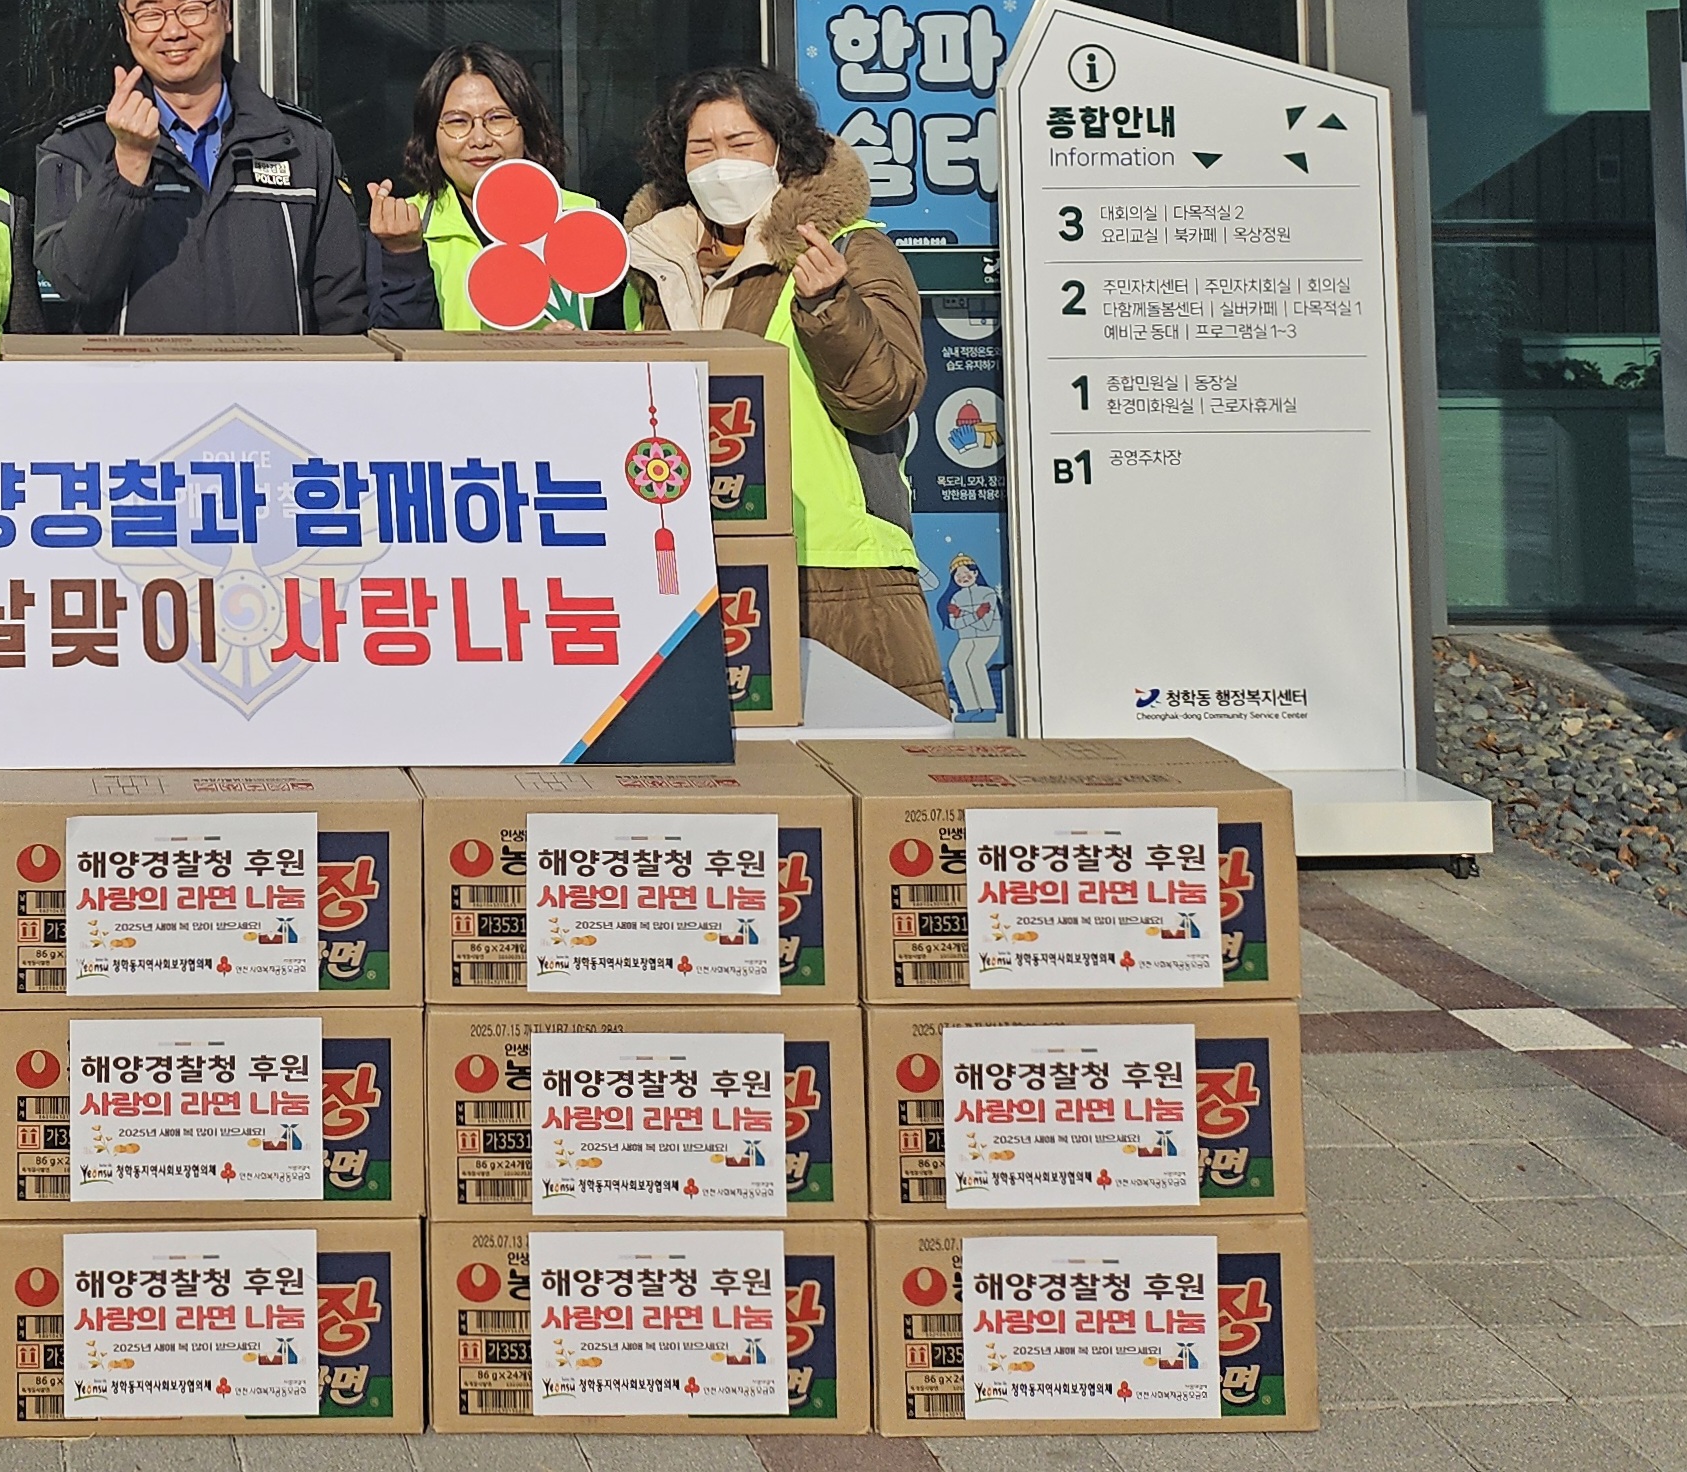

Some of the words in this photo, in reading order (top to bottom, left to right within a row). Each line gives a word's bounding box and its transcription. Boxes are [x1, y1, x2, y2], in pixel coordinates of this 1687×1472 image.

[827, 6, 1005, 98] 한파
[1047, 106, 1175, 138] 종합안내
[1050, 147, 1174, 166] Information
[255, 172, 290, 186] POLICE
[1100, 205, 1158, 221] 대회의실
[1173, 205, 1231, 221] 다목적실
[1235, 206, 1245, 220] 2
[1058, 206, 1084, 242] 3
[1101, 228, 1159, 244] 요리교실
[1174, 228, 1217, 244] 북카페
[1233, 227, 1291, 243] 옥상정원
[1102, 279, 1189, 295] 주민자치센터
[1204, 278, 1291, 295] 주민자치회실
[1307, 278, 1351, 294] 회의실
[1061, 279, 1087, 316] 2
[1103, 301, 1204, 318] 다함께돌봄센터
[1220, 301, 1278, 317] 실버카페
[1293, 301, 1352, 317] 다목적실
[1355, 301, 1362, 315] 1
[1104, 324, 1147, 340] 예비군
[1150, 324, 1179, 340] 동대
[1195, 324, 1267, 340] 프로그램실
[1270, 324, 1297, 339] 1~3
[942, 347, 959, 357] 실내
[946, 360, 964, 371] 습도
[965, 360, 999, 371] 유지하기
[1071, 375, 1089, 411] 1
[1106, 375, 1179, 392] 종합민원실
[1194, 375, 1238, 392] 동장실
[1107, 398, 1194, 415] 환경미화원실
[1210, 397, 1297, 414] 근로자휴게실
[1053, 449, 1092, 485] B1
[1109, 449, 1182, 466] 공영주차장
[291, 456, 608, 549] 함께하는
[942, 490, 976, 501] 방한용품
[270, 575, 621, 666] 사랑나눔
[1166, 689, 1211, 707] 청학동
[1215, 688, 1308, 707] 행정복지센터
[1136, 712, 1202, 721] Cheonghak-dong
[1203, 711, 1247, 720] Community
[1250, 711, 1279, 719] Service
[1281, 711, 1308, 719] Center
[905, 809, 956, 823] 2025.07.15
[537, 848, 692, 879] 해양경찰청
[703, 849, 765, 878] 후원
[537, 884, 628, 910] 사랑의
[637, 884, 698, 911] 라면
[705, 885, 767, 912] 나눔
[471, 1024, 520, 1037] 2025.07.15
[79, 1054, 236, 1085] 해양경찰청
[247, 1054, 309, 1083] 후원
[953, 1061, 1110, 1092] 해양경찰청
[1121, 1060, 1183, 1090] 후원
[79, 1090, 171, 1118] 사랑의
[180, 1090, 242, 1118] 라면
[249, 1090, 311, 1117] 나눔
[953, 1097, 1046, 1125] 사랑의
[1054, 1097, 1116, 1124] 라면
[1123, 1097, 1185, 1123] 나눔
[539, 1267, 698, 1298] 해양경찰청
[709, 1268, 771, 1297] 후원
[540, 1304, 633, 1331] 사랑의
[642, 1304, 705, 1331] 라면
[711, 1304, 774, 1331] 나눔
